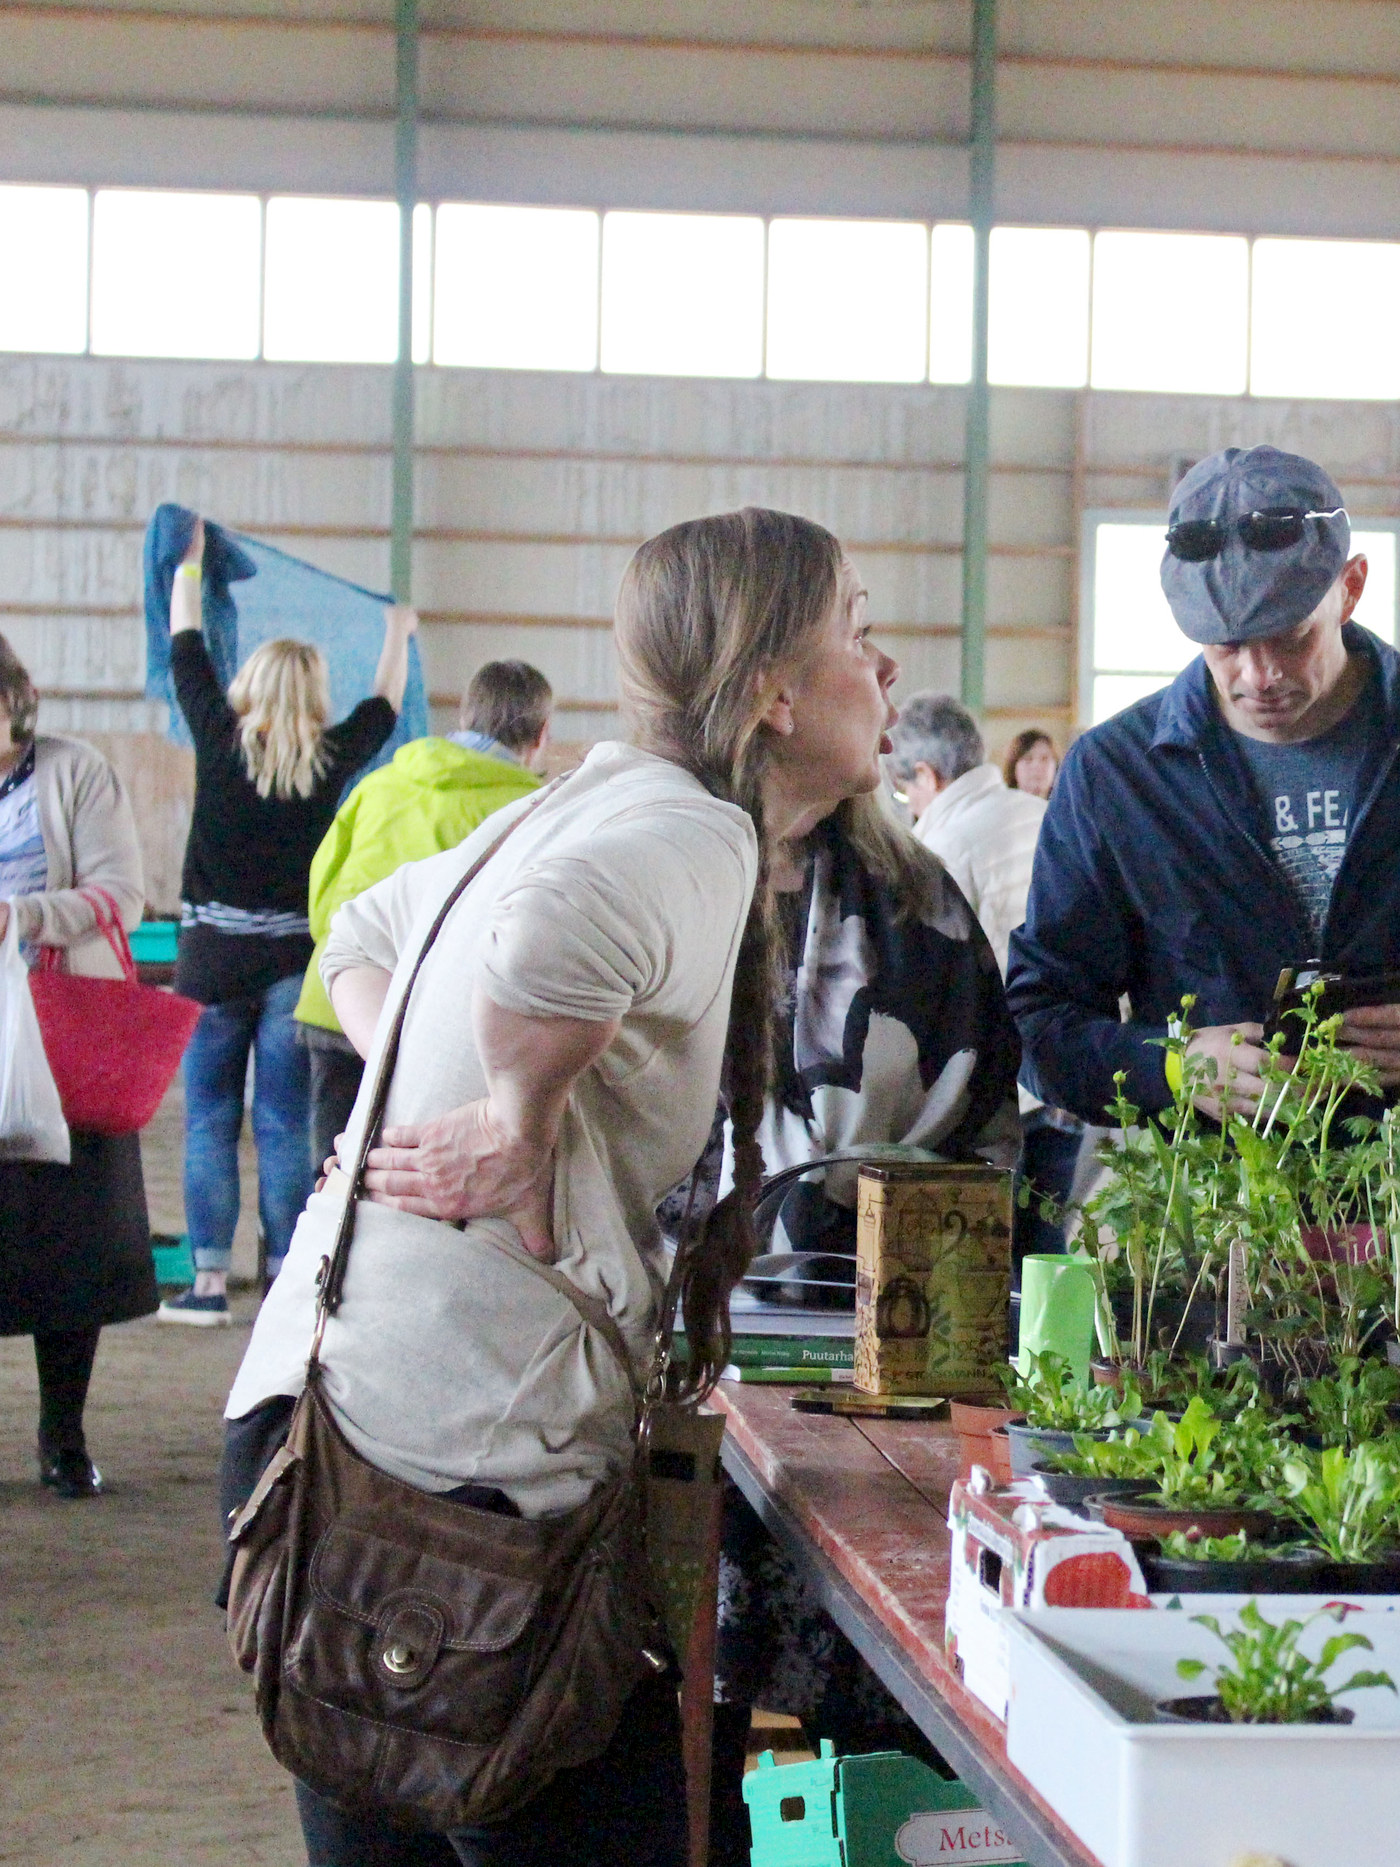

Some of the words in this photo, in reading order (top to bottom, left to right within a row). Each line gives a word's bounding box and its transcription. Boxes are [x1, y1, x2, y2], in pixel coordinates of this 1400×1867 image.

[1275, 795, 1298, 832] &
[1307, 790, 1348, 828] FE
[802, 1349, 854, 1361] Puutarha
